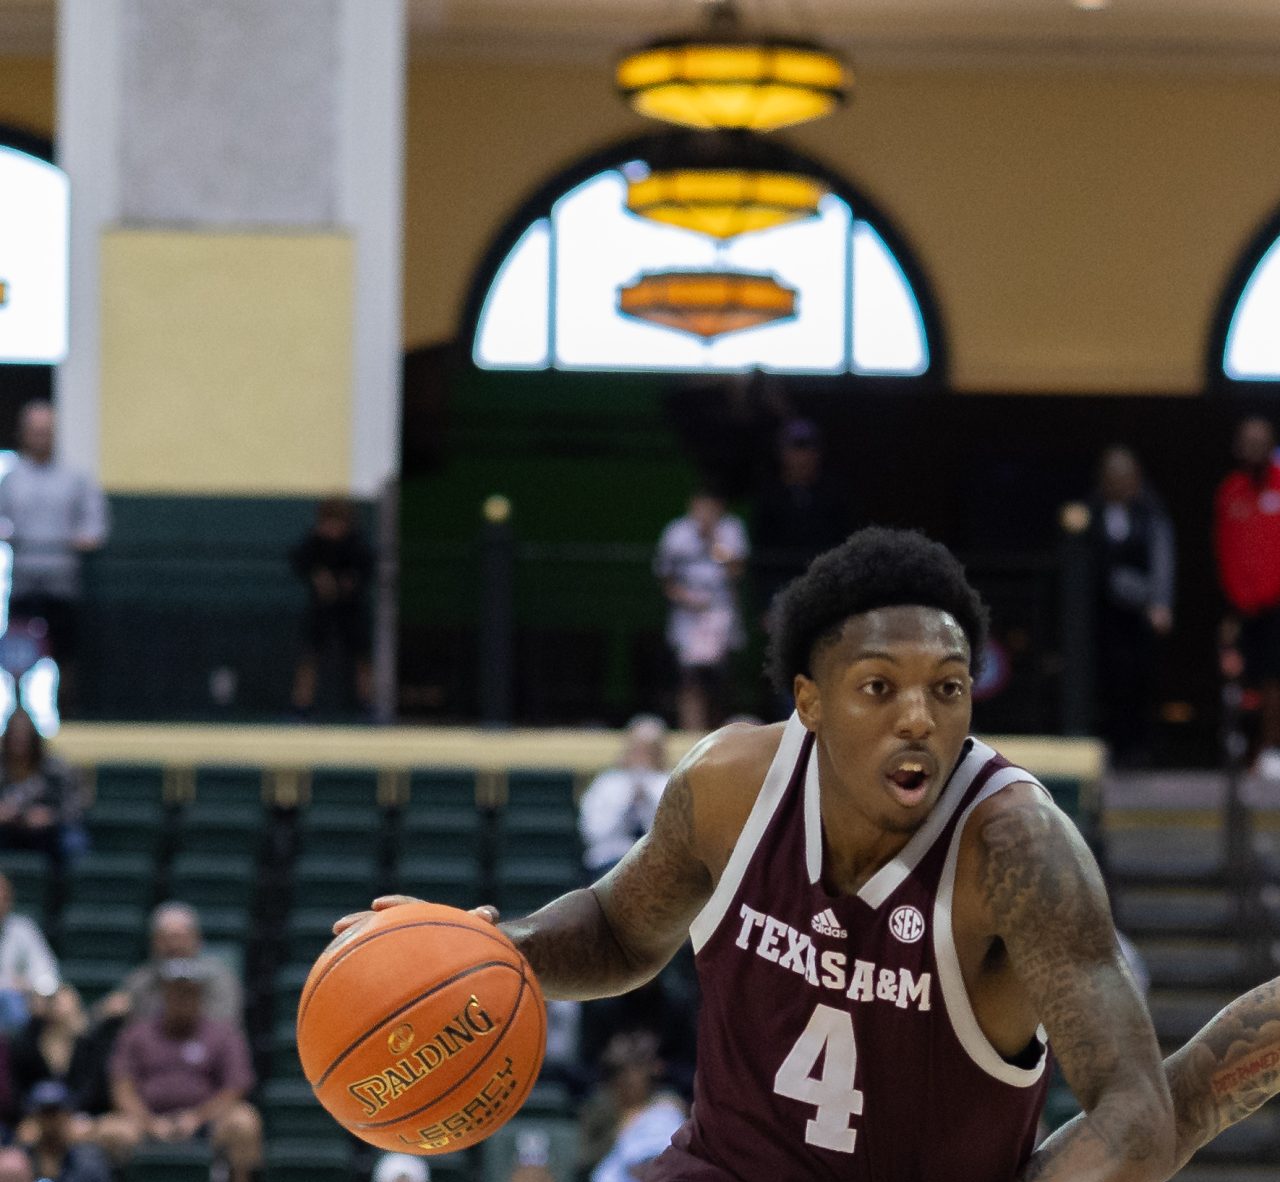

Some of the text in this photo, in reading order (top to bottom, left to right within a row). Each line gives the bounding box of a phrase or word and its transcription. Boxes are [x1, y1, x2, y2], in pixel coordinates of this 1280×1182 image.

[811, 919, 848, 939] adidas
[893, 909, 922, 940] SEC
[846, 959, 932, 1011] A&M
[348, 994, 497, 1117] SPALDING
[773, 1002, 864, 1154] 4
[399, 1057, 512, 1144] LEGACY
